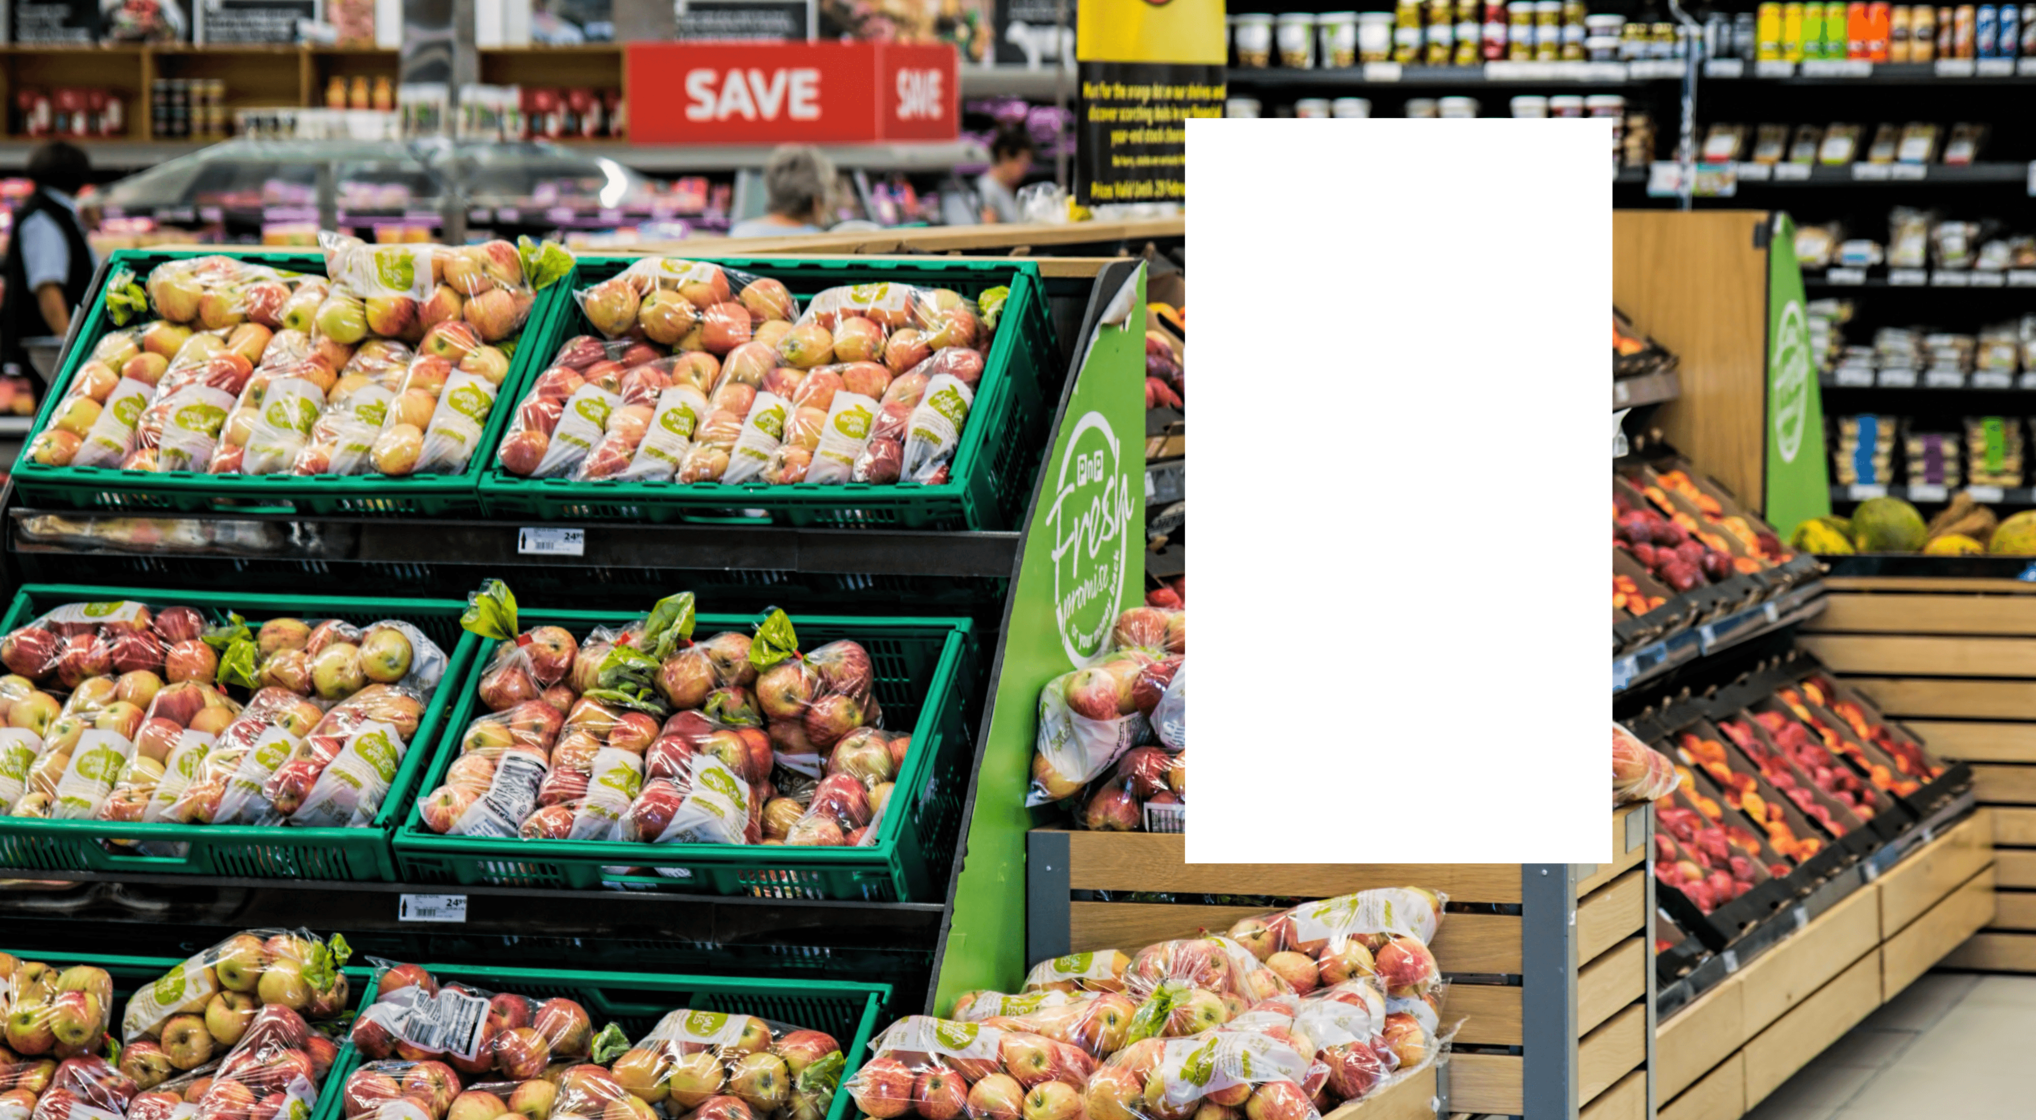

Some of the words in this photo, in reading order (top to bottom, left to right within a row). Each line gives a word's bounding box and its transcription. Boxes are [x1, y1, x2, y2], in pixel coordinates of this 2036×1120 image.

[684, 67, 822, 122] SAVE
[895, 67, 944, 121] SAVE
[1113, 81, 1126, 99] the
[1212, 82, 1227, 99] and
[1091, 181, 1114, 199] Prices
[1114, 180, 1133, 199] Valid
[1046, 438, 1134, 579] Fresh
[1062, 564, 1109, 645] promise
[1078, 633, 1094, 650] your
